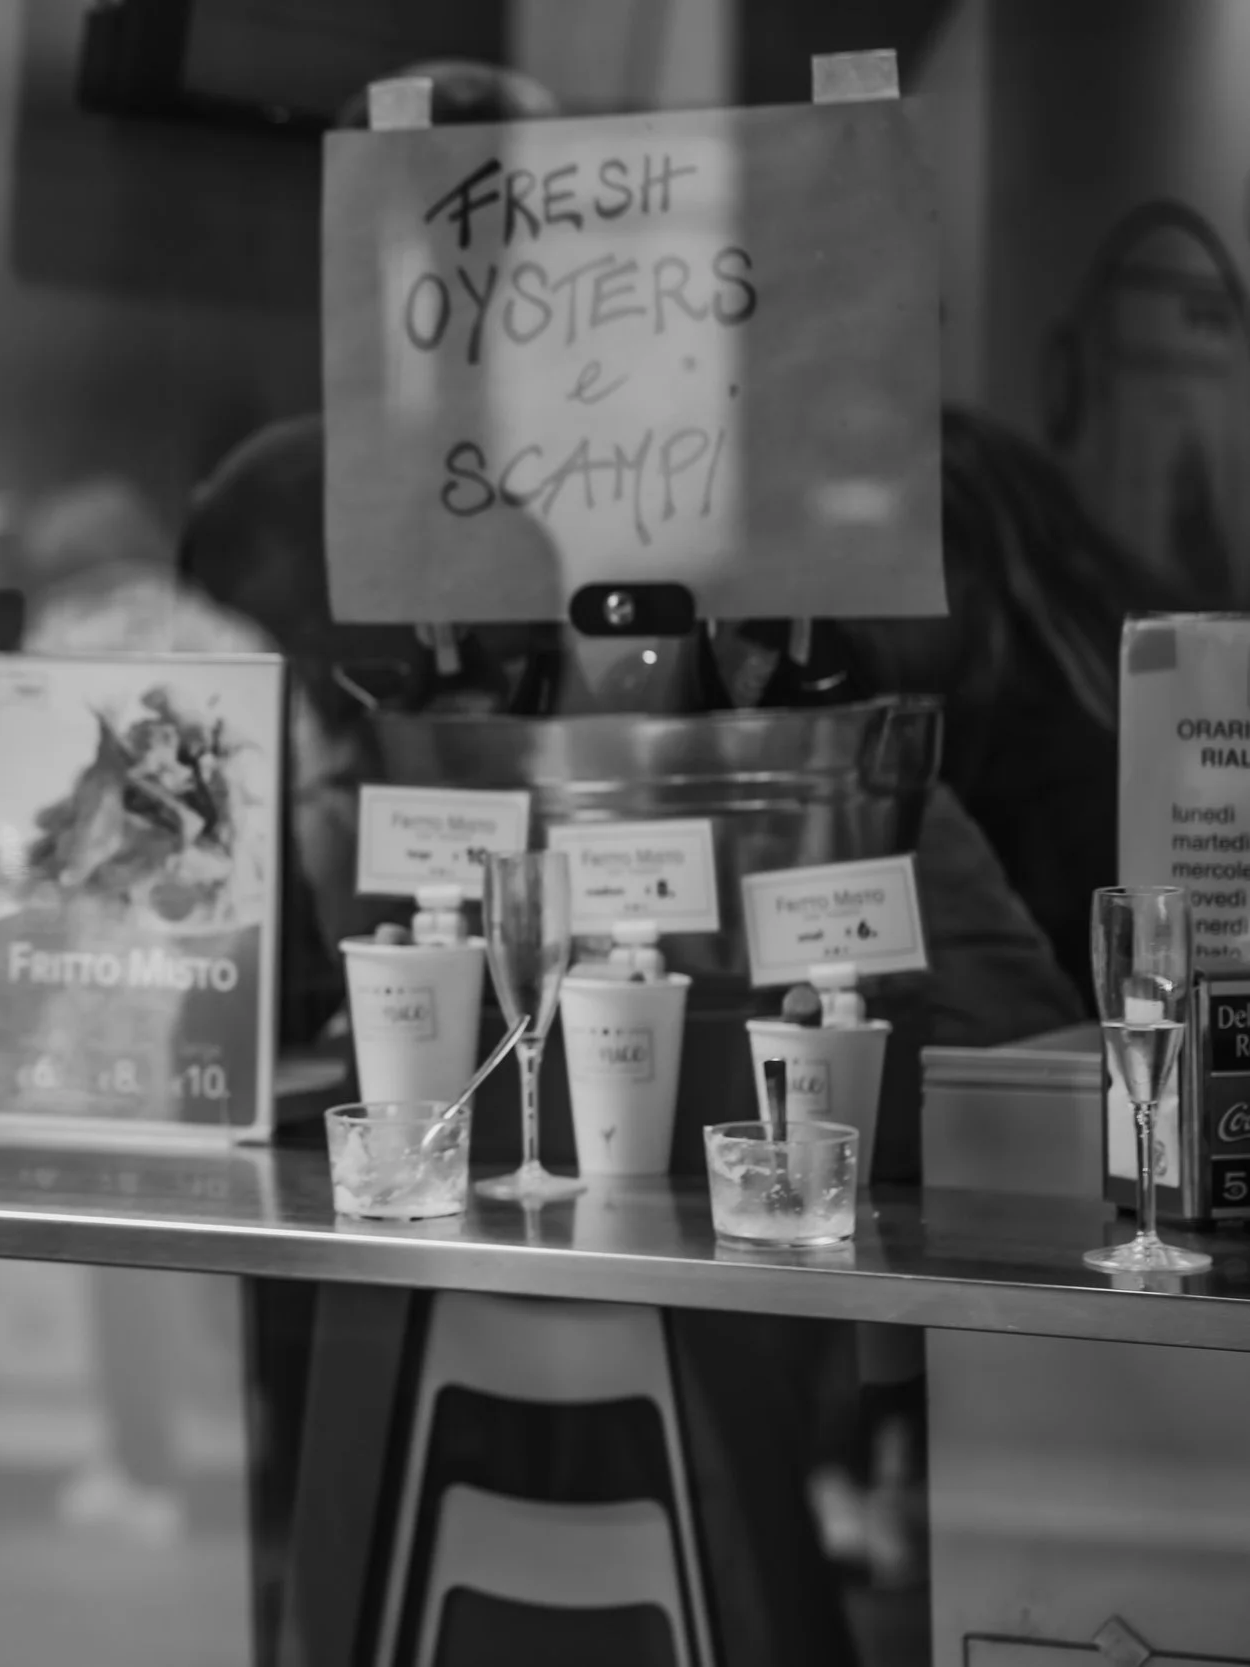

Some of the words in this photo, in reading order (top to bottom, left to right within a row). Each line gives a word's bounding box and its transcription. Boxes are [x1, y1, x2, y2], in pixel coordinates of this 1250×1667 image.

[424, 154, 698, 250] FRESH
[405, 247, 758, 365] OYSTERS
[441, 426, 727, 546] SCAMPI
[1200, 747, 1250, 769] RIAL
